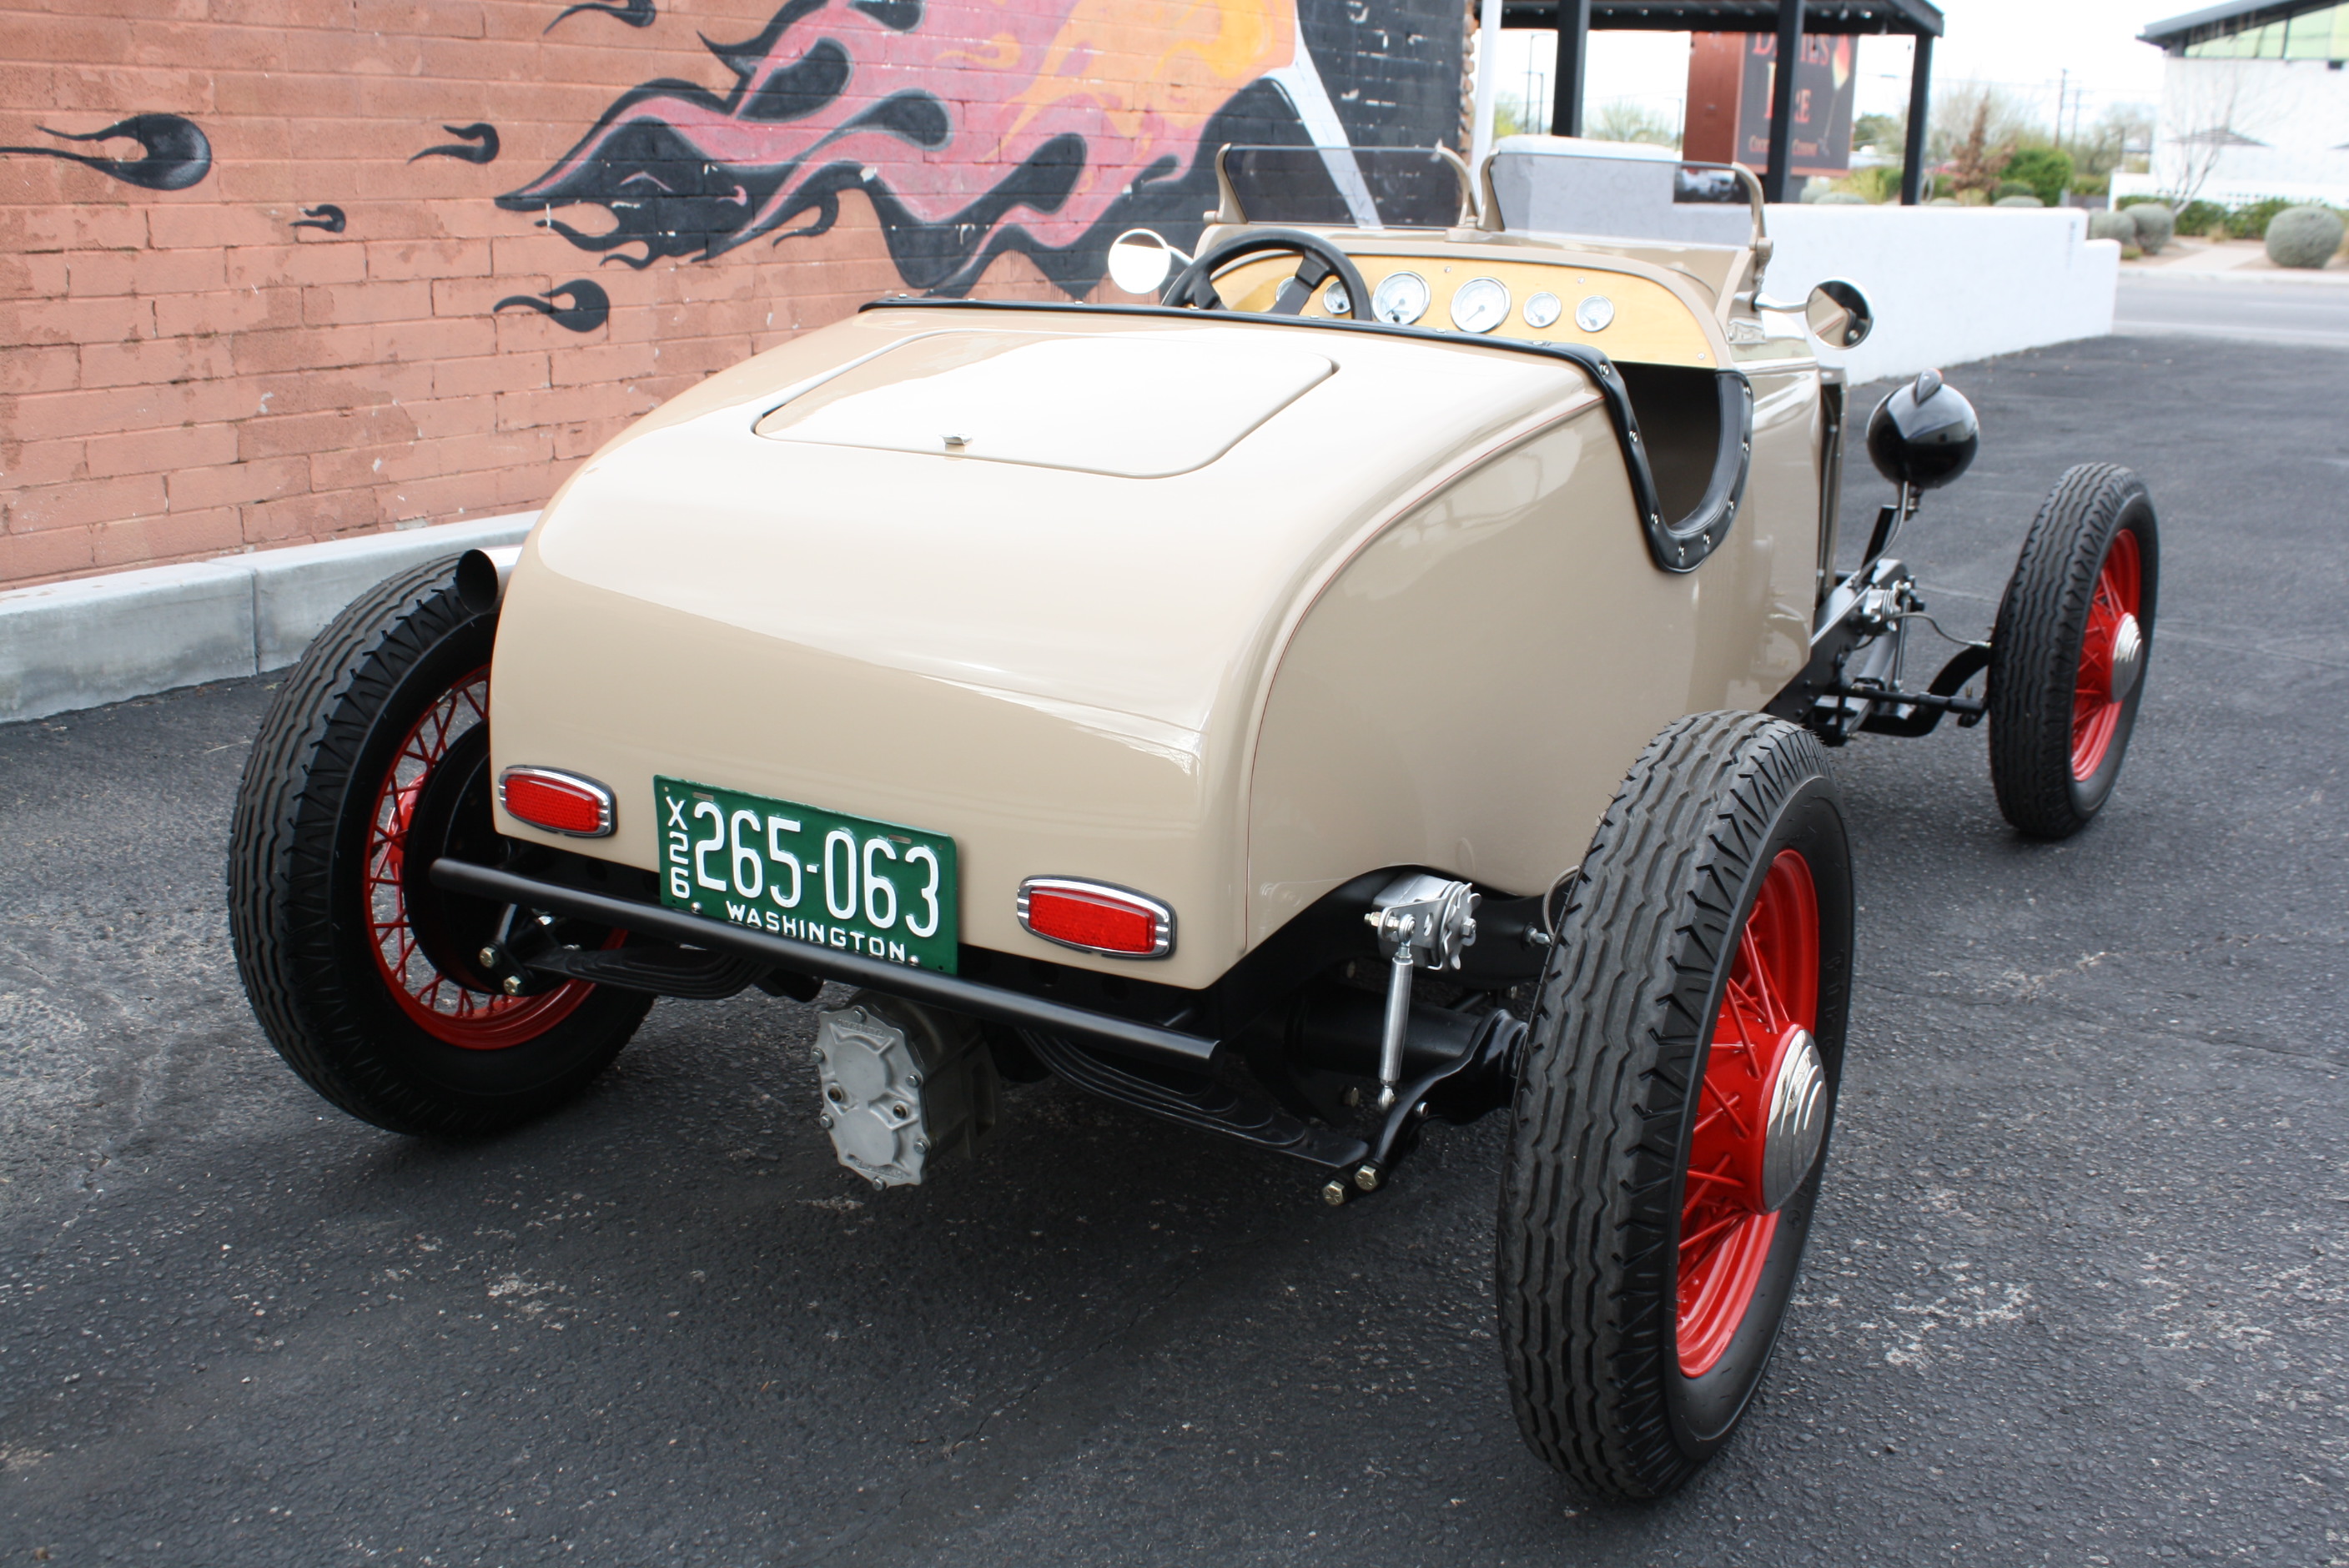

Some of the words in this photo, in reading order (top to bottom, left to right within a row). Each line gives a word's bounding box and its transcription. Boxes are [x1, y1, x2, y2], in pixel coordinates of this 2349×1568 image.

[666, 795, 691, 899] X26
[693, 801, 939, 938] 265-063
[726, 900, 906, 962] WASHINGTON
